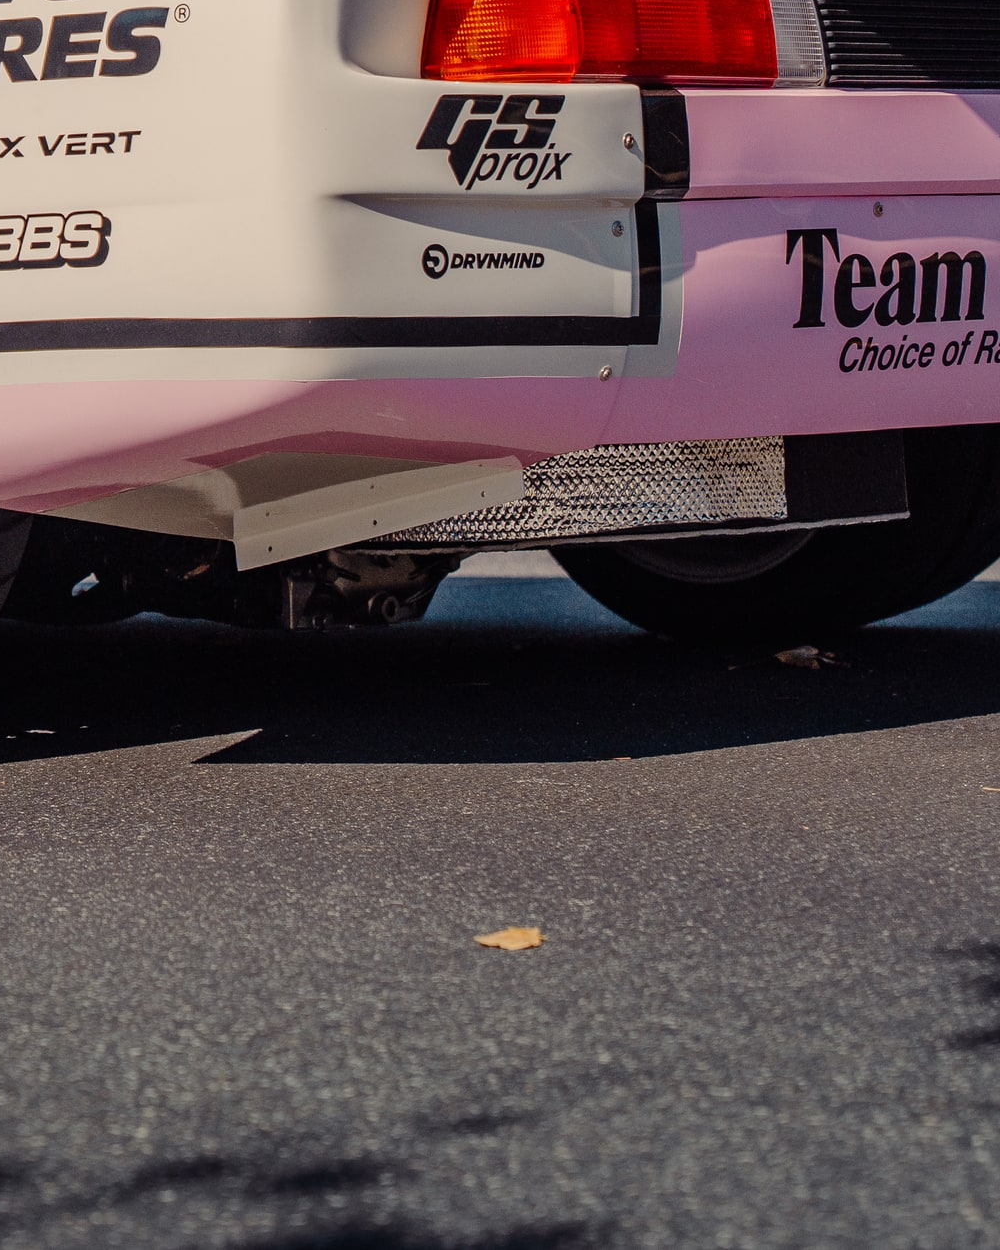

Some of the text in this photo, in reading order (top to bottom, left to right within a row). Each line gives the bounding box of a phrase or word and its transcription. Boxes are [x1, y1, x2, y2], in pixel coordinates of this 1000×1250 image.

[38, 130, 142, 156] VERT
[416, 94, 566, 186] GS
[465, 143, 573, 190] projx
[450, 252, 545, 269] DRVNMIND
[786, 228, 986, 329] Team
[839, 330, 1000, 373] Choice of R
